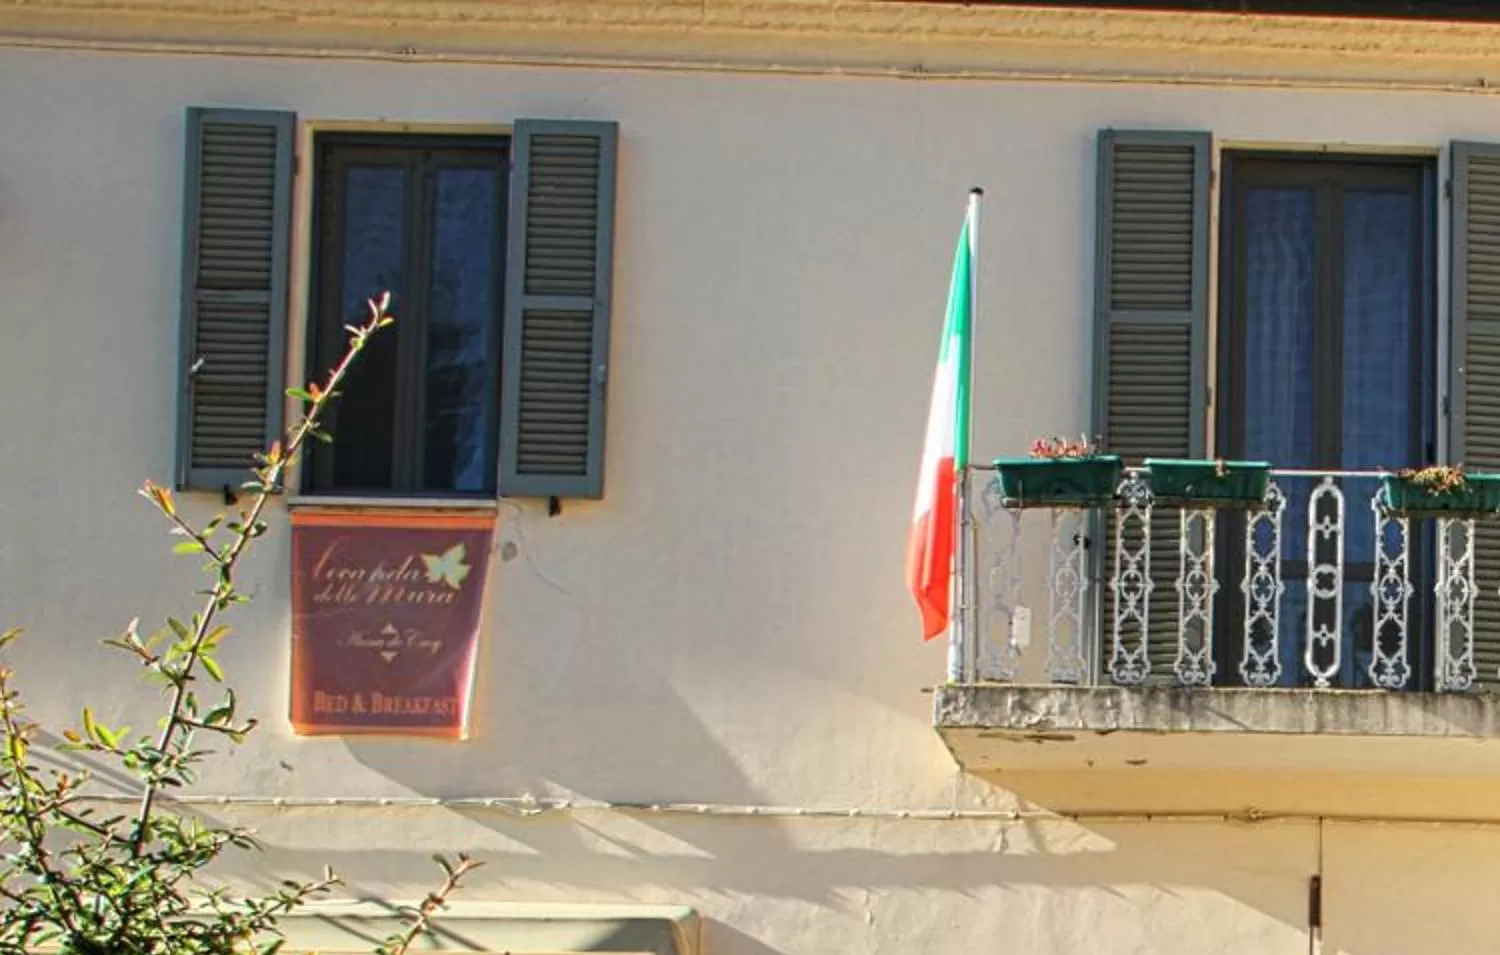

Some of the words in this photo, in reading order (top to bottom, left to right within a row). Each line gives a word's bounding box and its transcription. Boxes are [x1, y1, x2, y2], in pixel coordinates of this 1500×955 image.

[313, 691, 348, 713] BED
[353, 693, 365, 714] &
[372, 692, 458, 716] BREAKFAST
